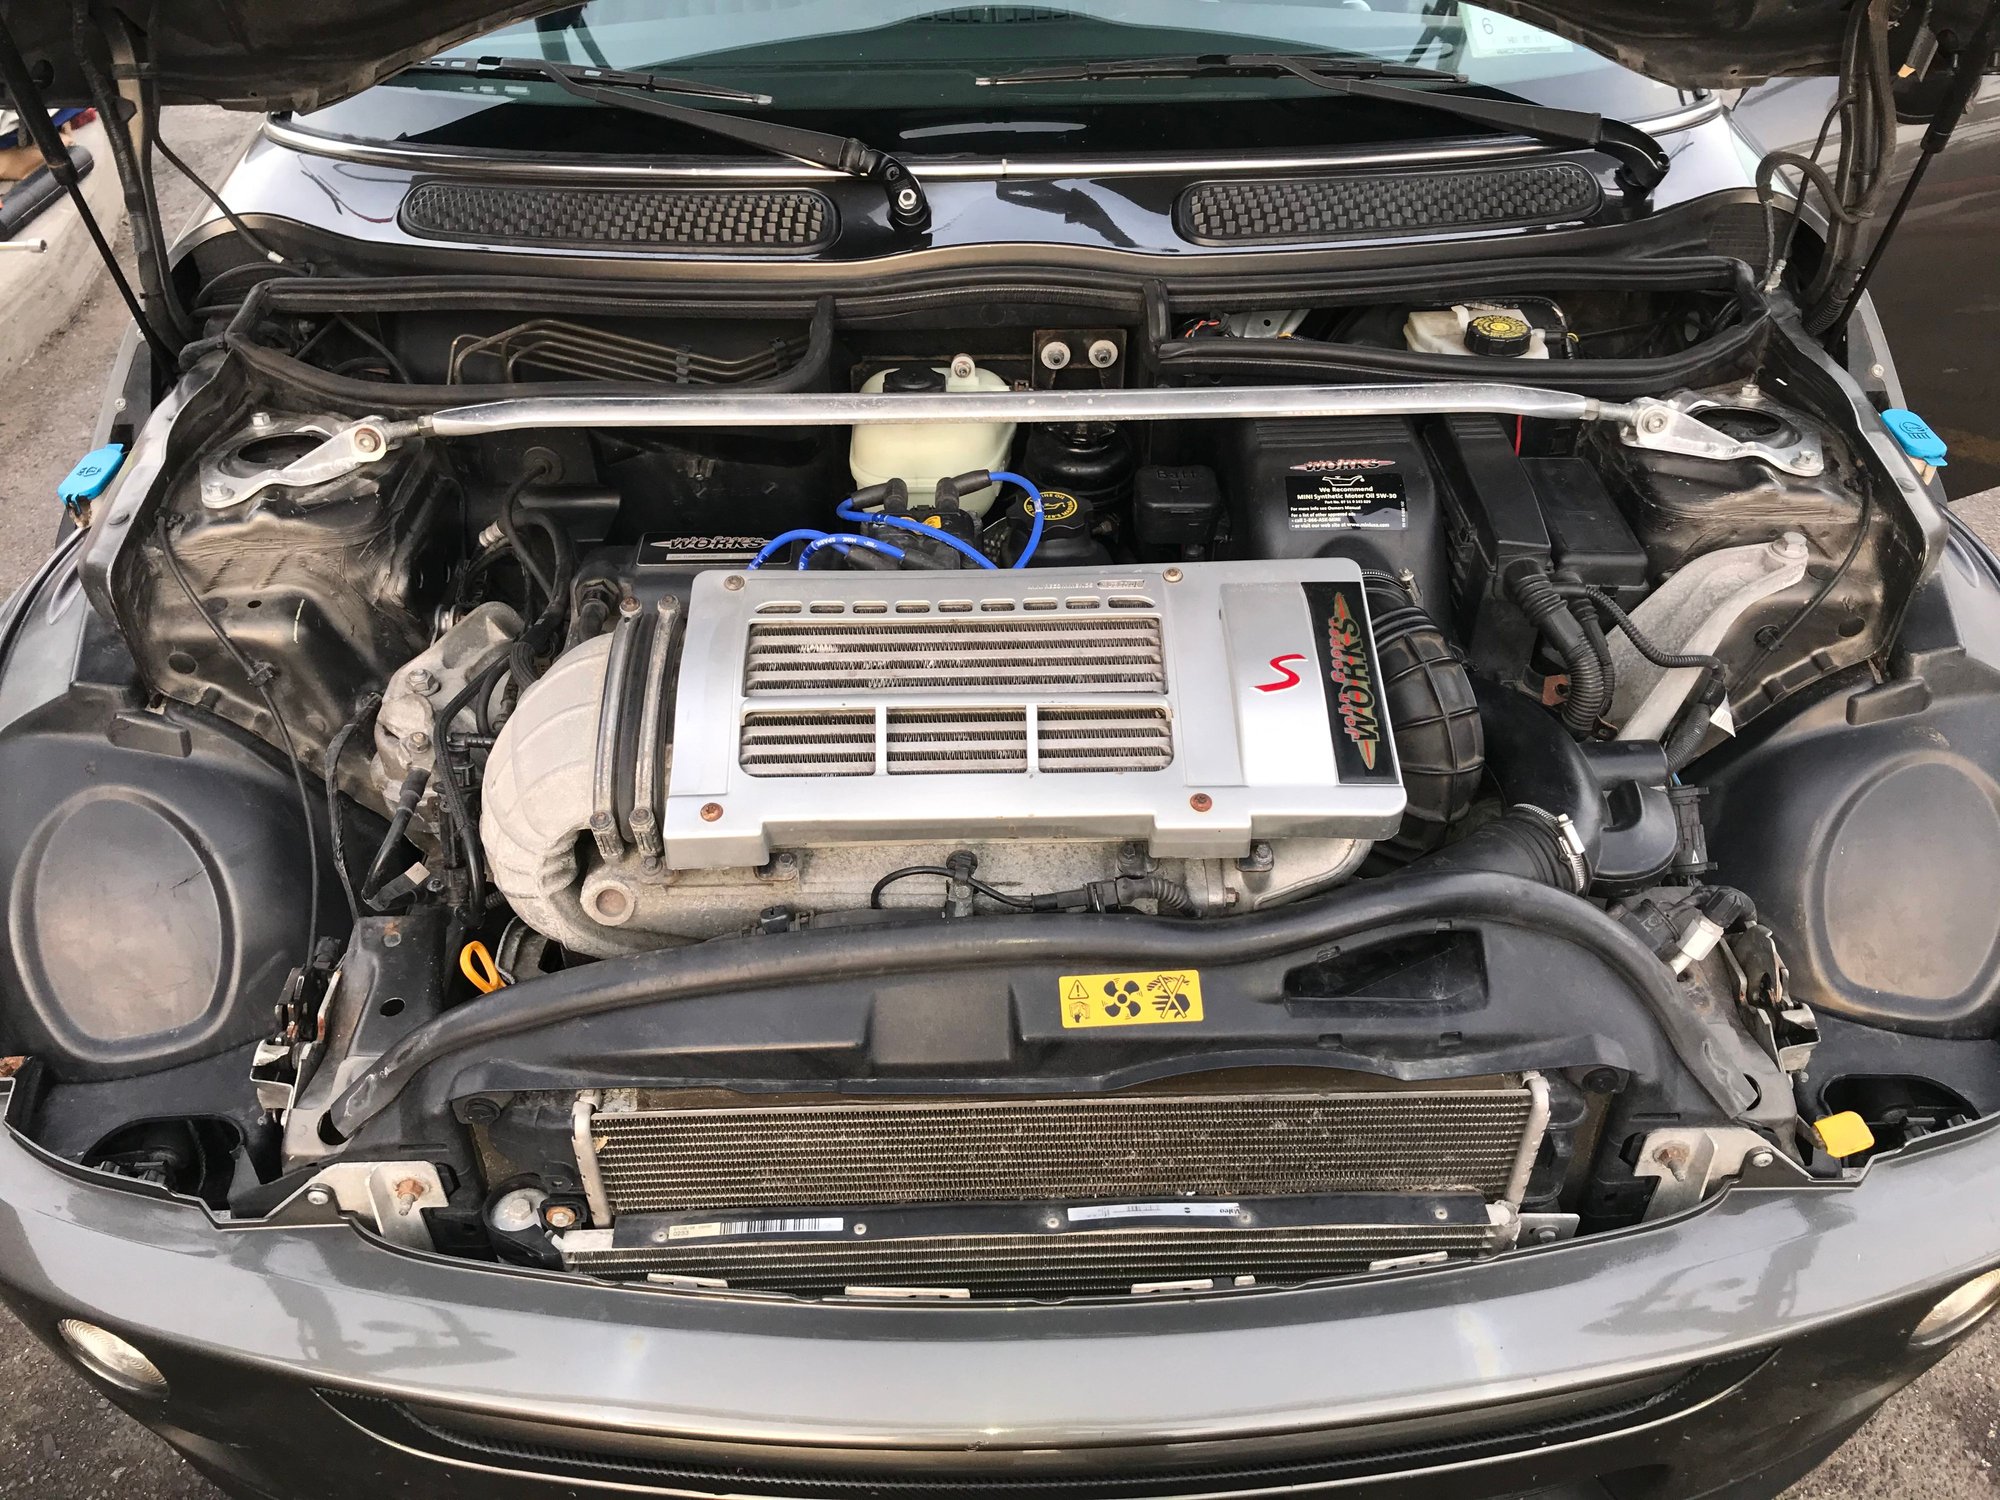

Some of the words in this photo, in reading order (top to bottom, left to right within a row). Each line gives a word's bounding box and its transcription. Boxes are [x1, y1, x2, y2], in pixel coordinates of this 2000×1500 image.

[669, 538, 767, 549] WORKS
[1327, 616, 1347, 684] Cooper
[1249, 653, 1308, 695] S
[1335, 618, 1381, 742] WORKS
[1338, 693, 1360, 740] John
